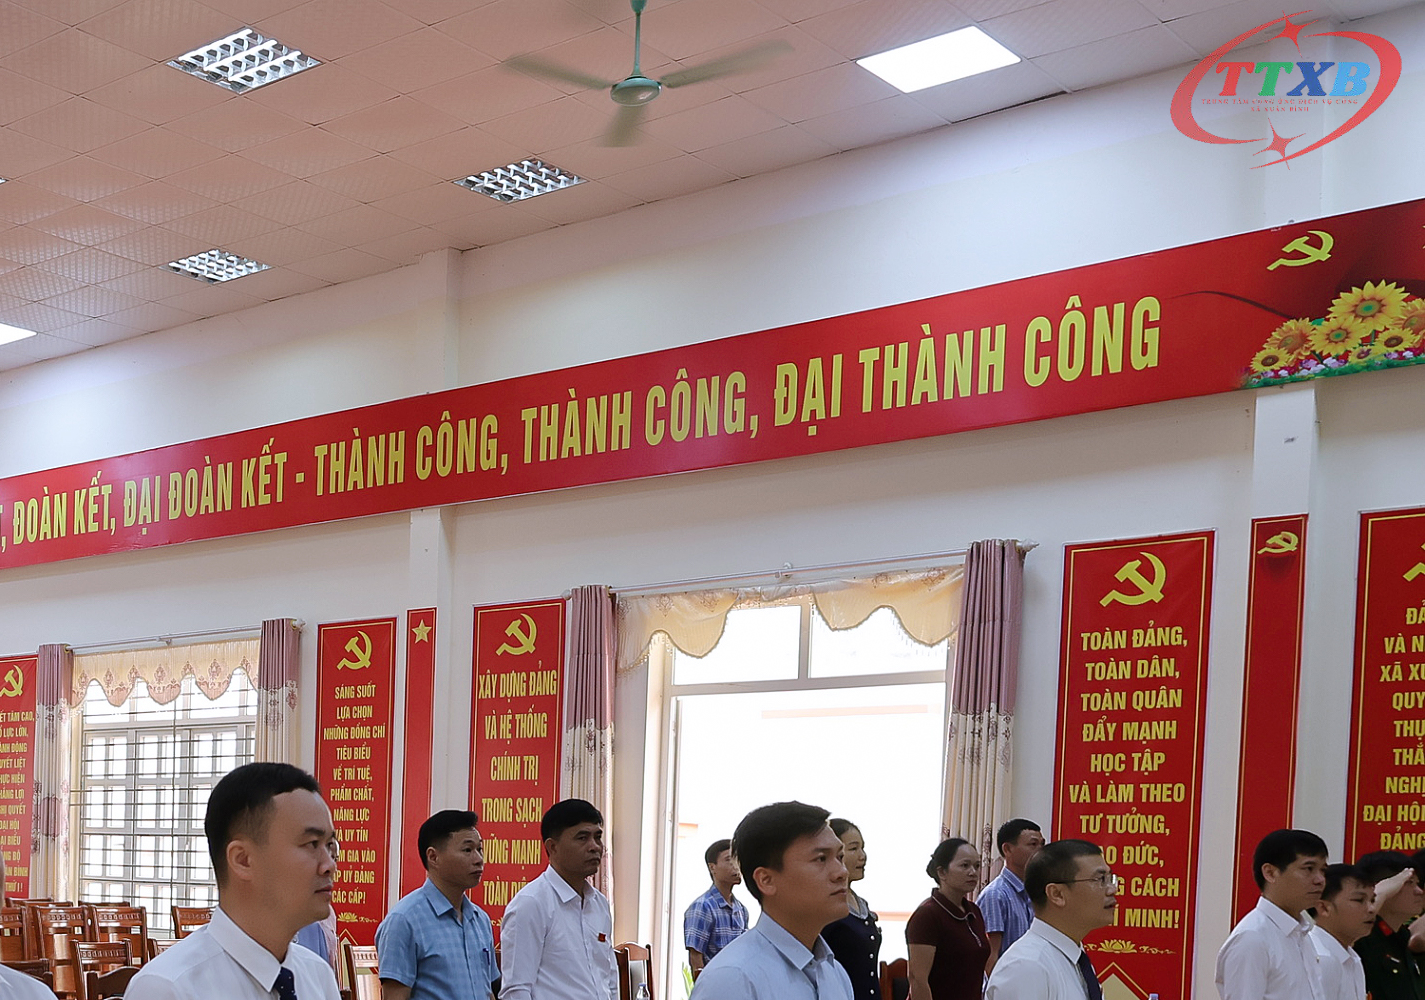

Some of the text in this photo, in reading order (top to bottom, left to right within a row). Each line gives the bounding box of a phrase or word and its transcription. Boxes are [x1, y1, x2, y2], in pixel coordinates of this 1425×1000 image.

[12, 485, 67, 546] ĐOÀN
[73, 469, 117, 538] KẾT,
[124, 486, 159, 542] ĐẠI
[167, 458, 233, 519] ĐOÀN
[241, 436, 288, 508] KẾT
[314, 428, 406, 497] THÀNH
[416, 410, 507, 481] CÔNG,
[521, 387, 634, 465] THÀNH
[643, 367, 758, 446] CÔNG,
[774, 358, 840, 436] ĐẠI
[859, 322, 1007, 414] THÀNH
[1023, 294, 1162, 388] CÔNG
[1081, 620, 1187, 651] TOÀN ĐẢNG,
[1384, 633, 1405, 653] VÀ
[1086, 657, 1180, 681] TOÀN DÂN,
[1380, 661, 1403, 681] XÃ
[335, 681, 376, 699] SÁNG SUỐT
[479, 660, 557, 703] XÂY DỰNG ĐẢNG
[1081, 686, 1182, 711] TOÀN QUÂN
[337, 705, 372, 722] LỰA CHỌN
[485, 704, 547, 744] VÀ HỆ THỐNG
[324, 724, 348, 740] NHỮNG
[372, 723, 385, 738] CHÍ
[1082, 715, 1177, 745] ĐẨY MẠNH
[336, 741, 371, 760] TIÊU BIỂU
[1090, 747, 1166, 777] HỌC TẬP
[344, 765, 355, 780] TRÍ
[491, 751, 538, 785] CHÍNH TRỊ
[1069, 780, 1186, 804] VÀ LÀM THEO
[334, 806, 369, 823] NĂNG LỰC
[482, 798, 542, 828] TRONG SẠCH
[1080, 806, 1170, 836] TƯ TƯỞNG,
[1363, 805, 1392, 825] ĐẠI
[345, 829, 354, 841] UY
[356, 827, 368, 841] TÍN
[347, 850, 359, 862] GIA
[361, 847, 376, 862] VÀO
[483, 833, 541, 870] VỮNG MẠNH
[1123, 841, 1164, 867] ĐỨC,
[354, 865, 374, 883] ĐẢNG
[1131, 874, 1179, 897] CÁCH
[331, 888, 346, 903] CÁC
[483, 876, 508, 906] TOÀN
[1125, 908, 1179, 928] MINH!
